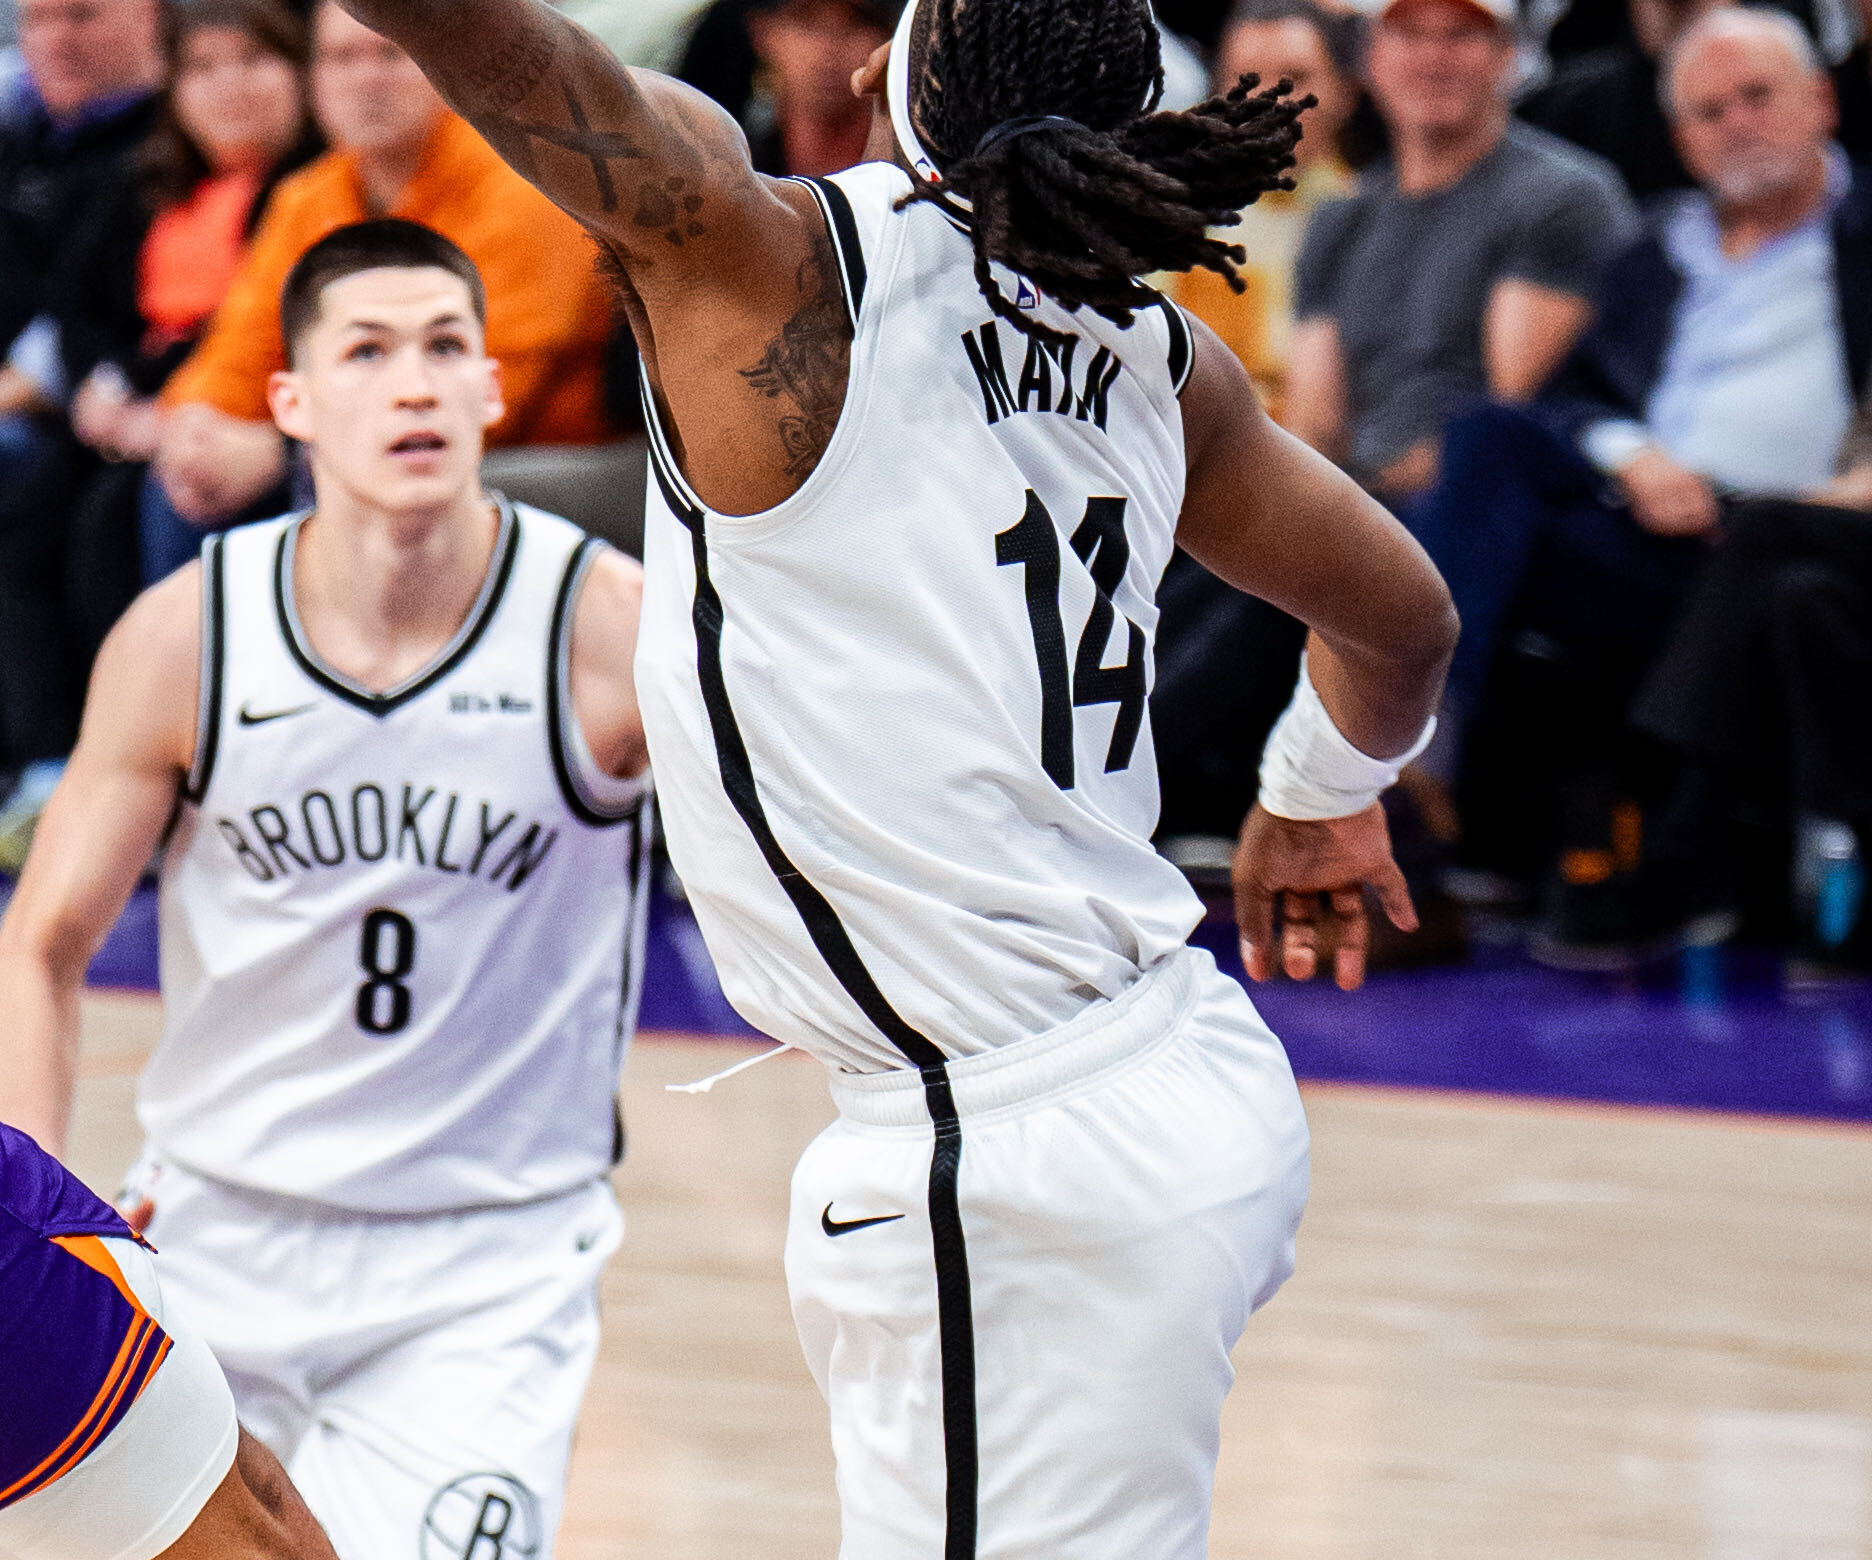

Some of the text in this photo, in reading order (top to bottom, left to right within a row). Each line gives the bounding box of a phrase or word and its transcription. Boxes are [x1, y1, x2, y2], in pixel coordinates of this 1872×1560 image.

[995, 488, 1147, 791] 14
[218, 783, 559, 892] BROOKLYN
[355, 906, 416, 1037] 8
